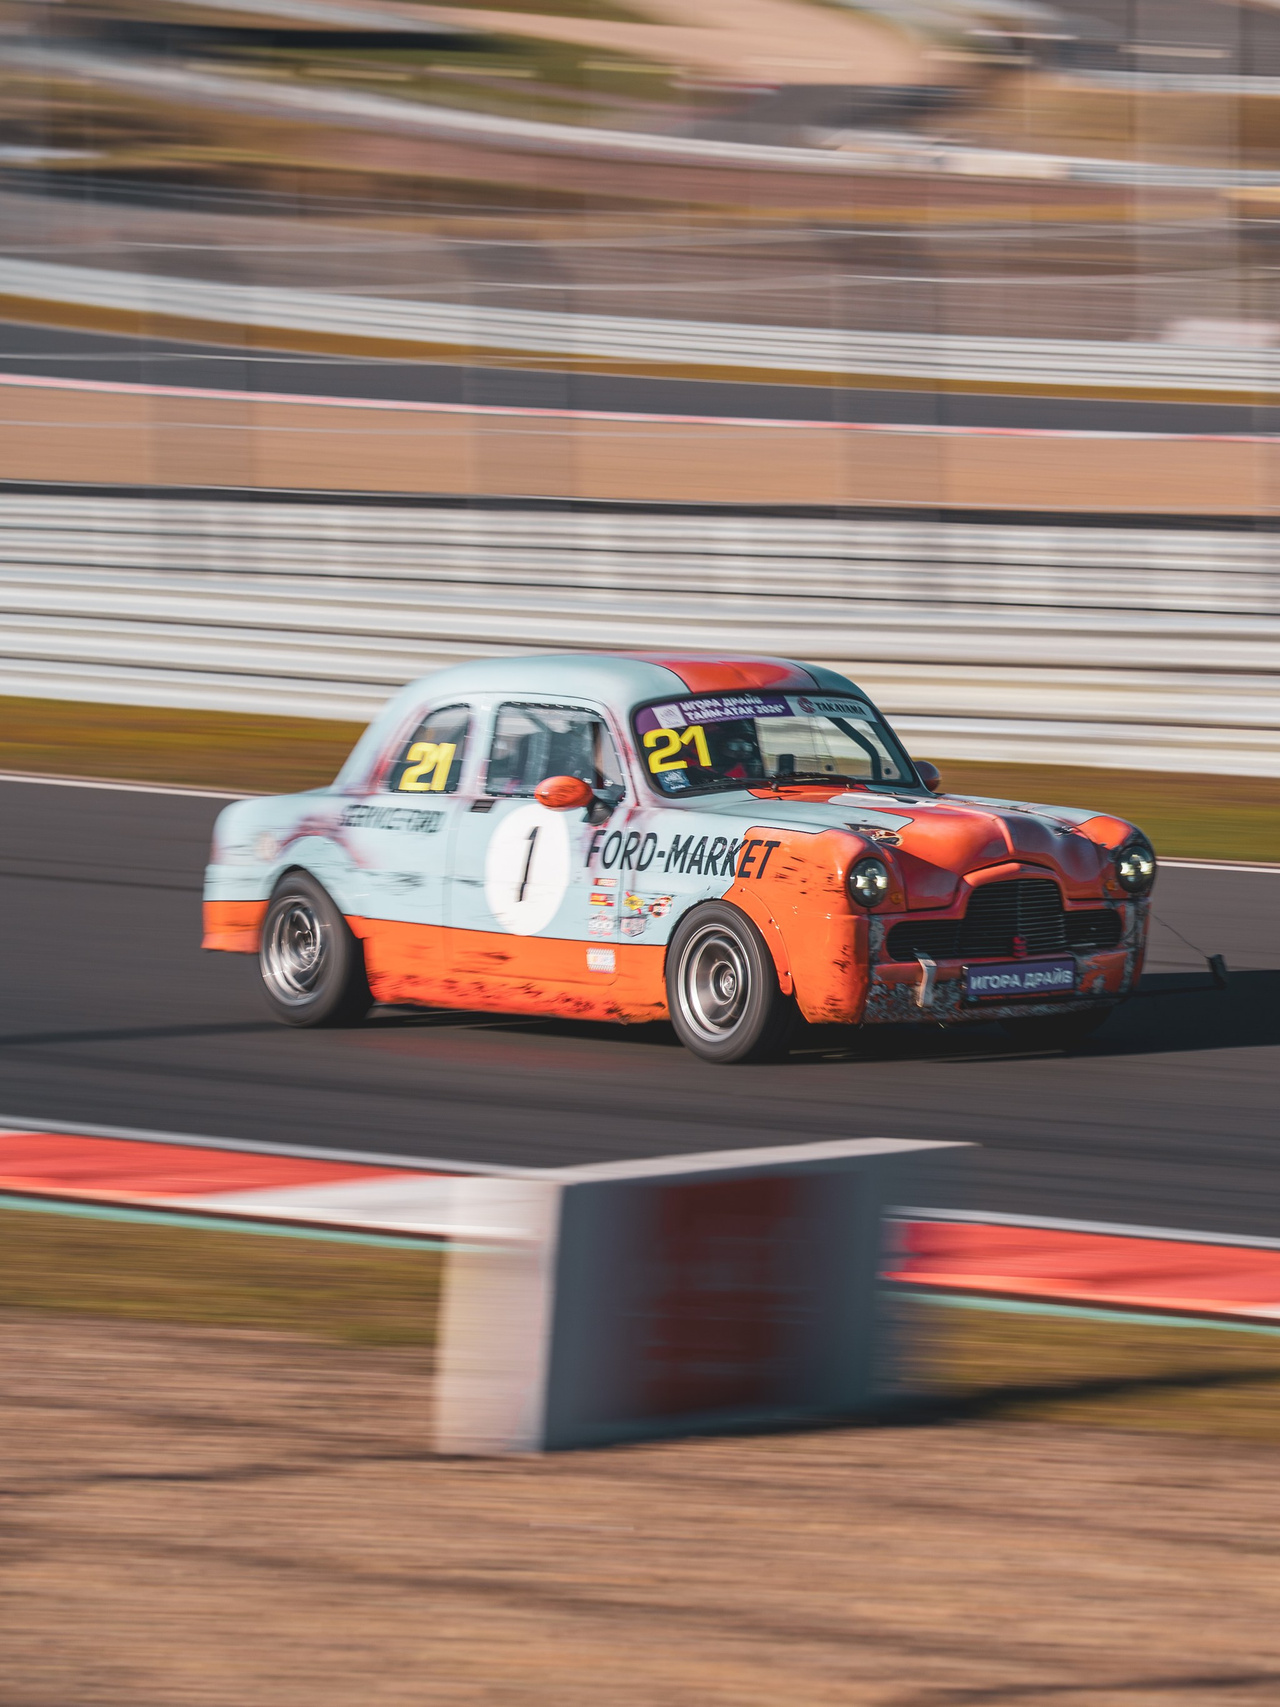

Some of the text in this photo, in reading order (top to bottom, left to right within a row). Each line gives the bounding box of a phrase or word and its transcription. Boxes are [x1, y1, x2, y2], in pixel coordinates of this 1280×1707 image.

[680, 693, 763, 711] ИГОРА ДРАЙВ
[814, 702, 867, 716] TAKAYAMA
[398, 742, 457, 791] 21
[643, 725, 712, 774] 21
[517, 826, 539, 902] 1
[585, 830, 780, 879] FORD-MARKET
[970, 967, 1074, 990] ИГОРА ДРАЙВ
